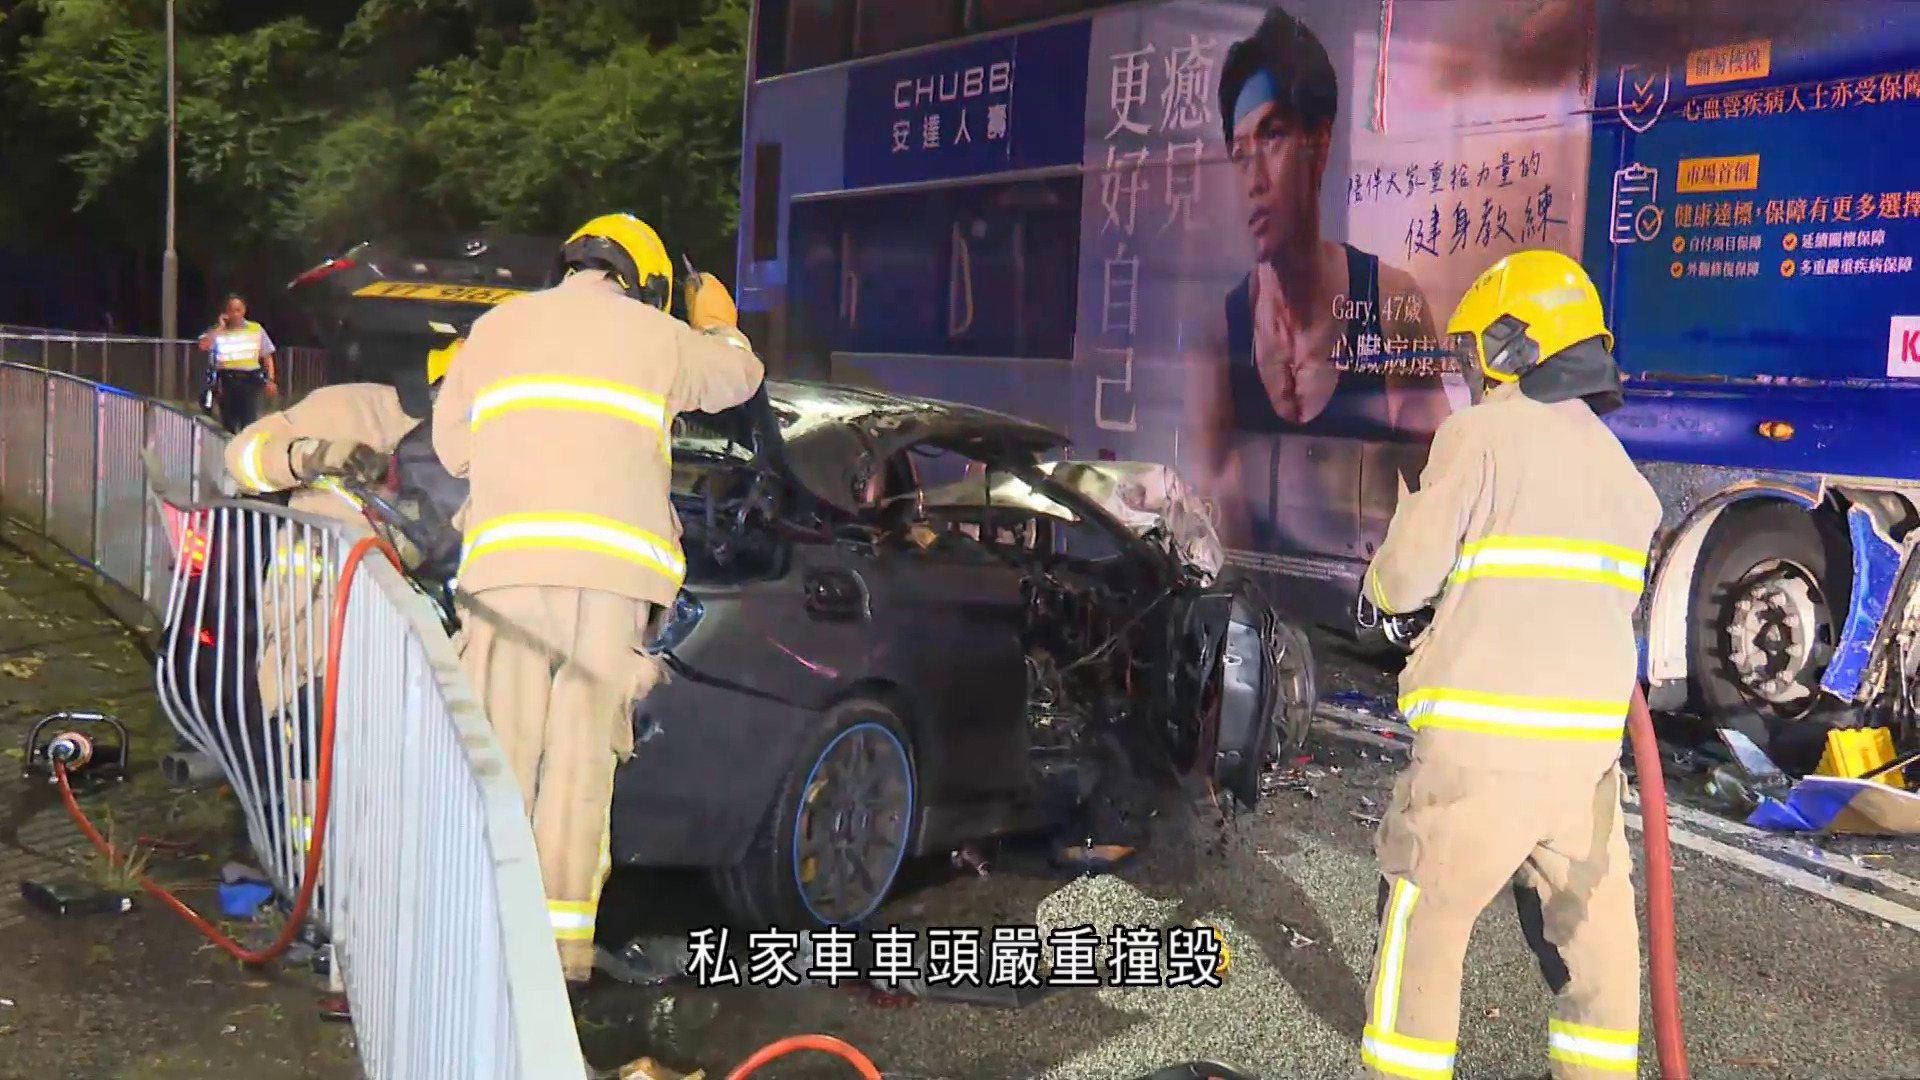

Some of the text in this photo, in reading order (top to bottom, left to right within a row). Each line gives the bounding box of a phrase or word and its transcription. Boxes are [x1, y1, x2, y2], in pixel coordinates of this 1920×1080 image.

[894, 62, 1010, 109] CHUBB
[892, 104, 1007, 152] 安達人壽
[1096, 44, 1156, 432] 更好自己
[1404, 184, 1568, 260] 健身教練
[1332, 294, 1377, 326] Gary,
